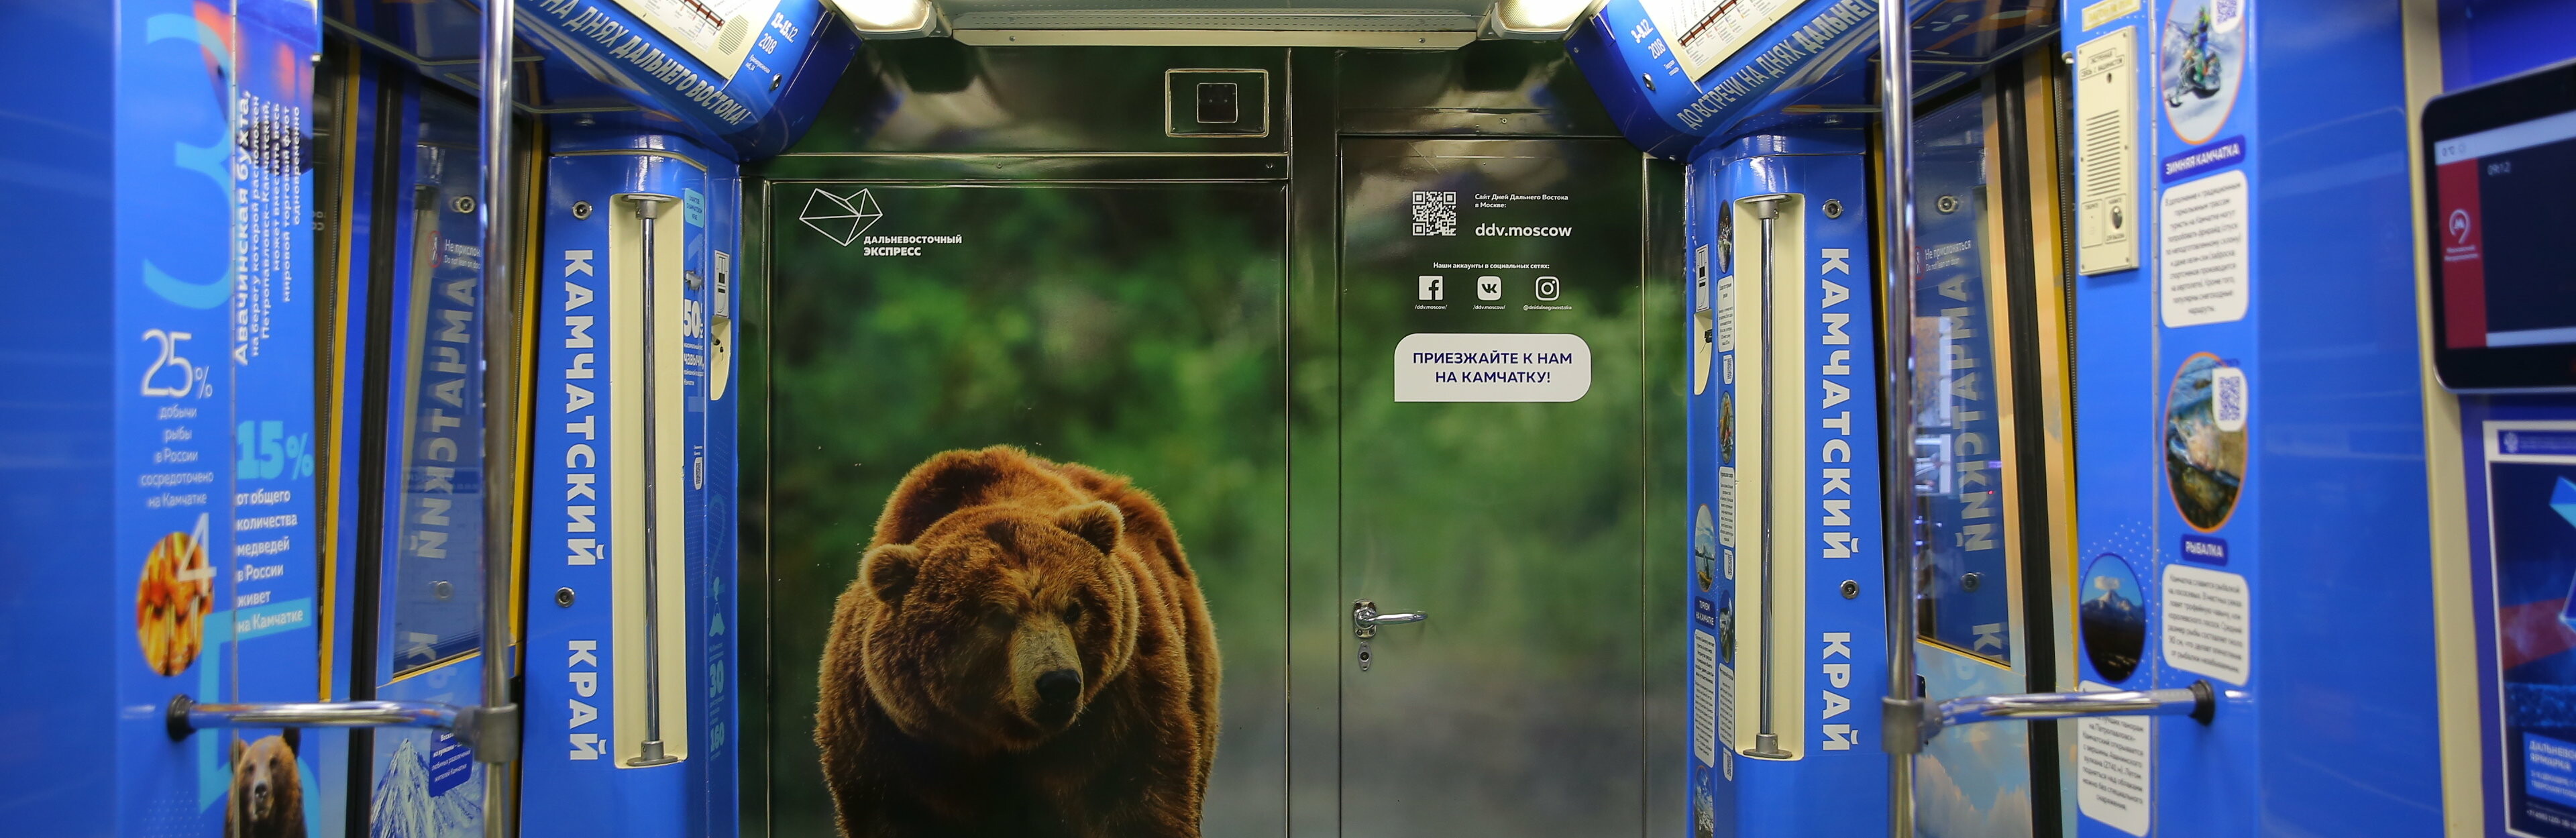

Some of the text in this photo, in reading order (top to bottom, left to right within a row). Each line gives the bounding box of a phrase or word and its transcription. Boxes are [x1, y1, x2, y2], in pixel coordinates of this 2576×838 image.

[758, 33, 777, 54] 2018
[1648, 38, 1666, 59] 2018
[562, 6, 629, 48] ДНЯХ
[610, 36, 698, 91] ДАЛЬНЕГО
[685, 80, 751, 125] ВОСТОКА!
[1676, 107, 1704, 130] ДО
[1693, 75, 1746, 117] ВСТРЕЧИ
[1736, 65, 1770, 94] НА
[1756, 39, 1806, 78] ДНЯХ
[2166, 143, 2240, 175] ЗИМНЯЯ КАМЧАТКА
[282, 106, 292, 301] мировой торговый флот
[235, 90, 251, 366] Авачинская бухта,
[252, 96, 261, 356] на берегу которой расположен
[1474, 223, 1572, 237] ddv.moscow
[445, 240, 481, 257] Не прислон
[863, 234, 962, 245] ДАЛЬНЕВОСТОЧНЫЙ
[863, 246, 922, 257] ЭКСПРЕСС
[1925, 240, 1971, 260] Не прислоняться
[1413, 350, 1572, 364] ПРИЕЗЖАЙТЕ К НАМ
[1436, 371, 1551, 383] НА КАМЧАТКУ!
[160, 404, 197, 419] добычи
[565, 250, 605, 566] КАМЧАТСКИЙ
[1821, 248, 1859, 559] КАМЧАТСКИЙ
[165, 427, 192, 443] рыбы
[156, 448, 198, 462] в России
[237, 421, 314, 481] 15%
[140, 471, 213, 487] сосредоточено
[148, 493, 207, 507] на Камчатке
[237, 489, 290, 505] от общего
[237, 514, 298, 531] количества
[178, 513, 217, 596] 4
[237, 535, 290, 556] медведей
[2186, 541, 2223, 558] РЫБАЛКА
[237, 564, 284, 582] в России
[237, 590, 271, 608] живет
[237, 609, 303, 633] на Камчатке
[710, 660, 724, 698] 30
[569, 641, 607, 760] КРАЙ
[1822, 633, 1858, 750] КРАЙ
